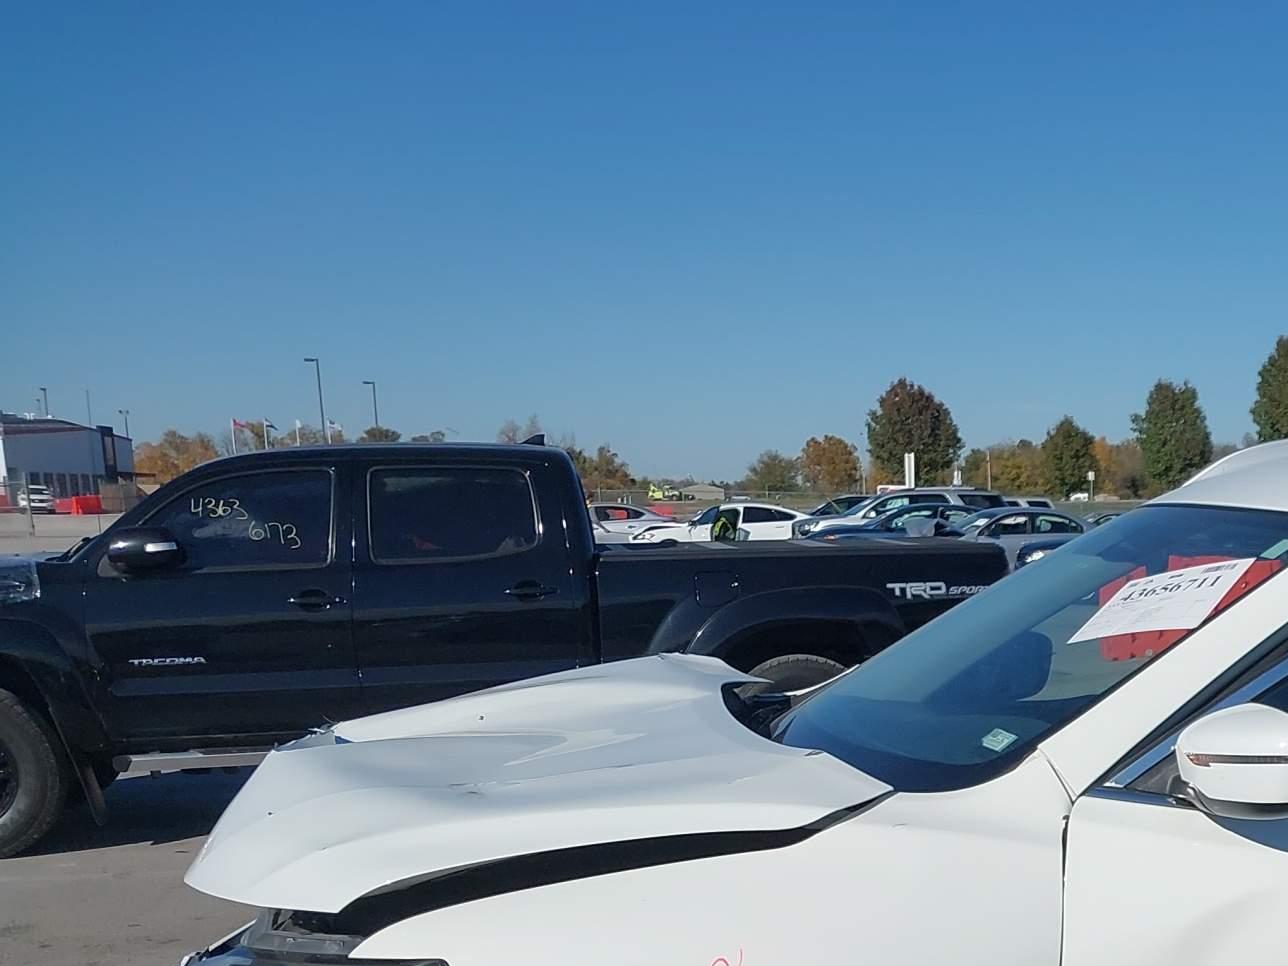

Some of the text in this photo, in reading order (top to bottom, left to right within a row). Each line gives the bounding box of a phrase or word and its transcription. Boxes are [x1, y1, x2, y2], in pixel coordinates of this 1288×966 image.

[190, 496, 249, 520] 4363
[247, 519, 302, 549] 6173
[886, 581, 946, 600] TRD
[1120, 574, 1223, 602] 43656711
[127, 656, 208, 667] TACOMA
